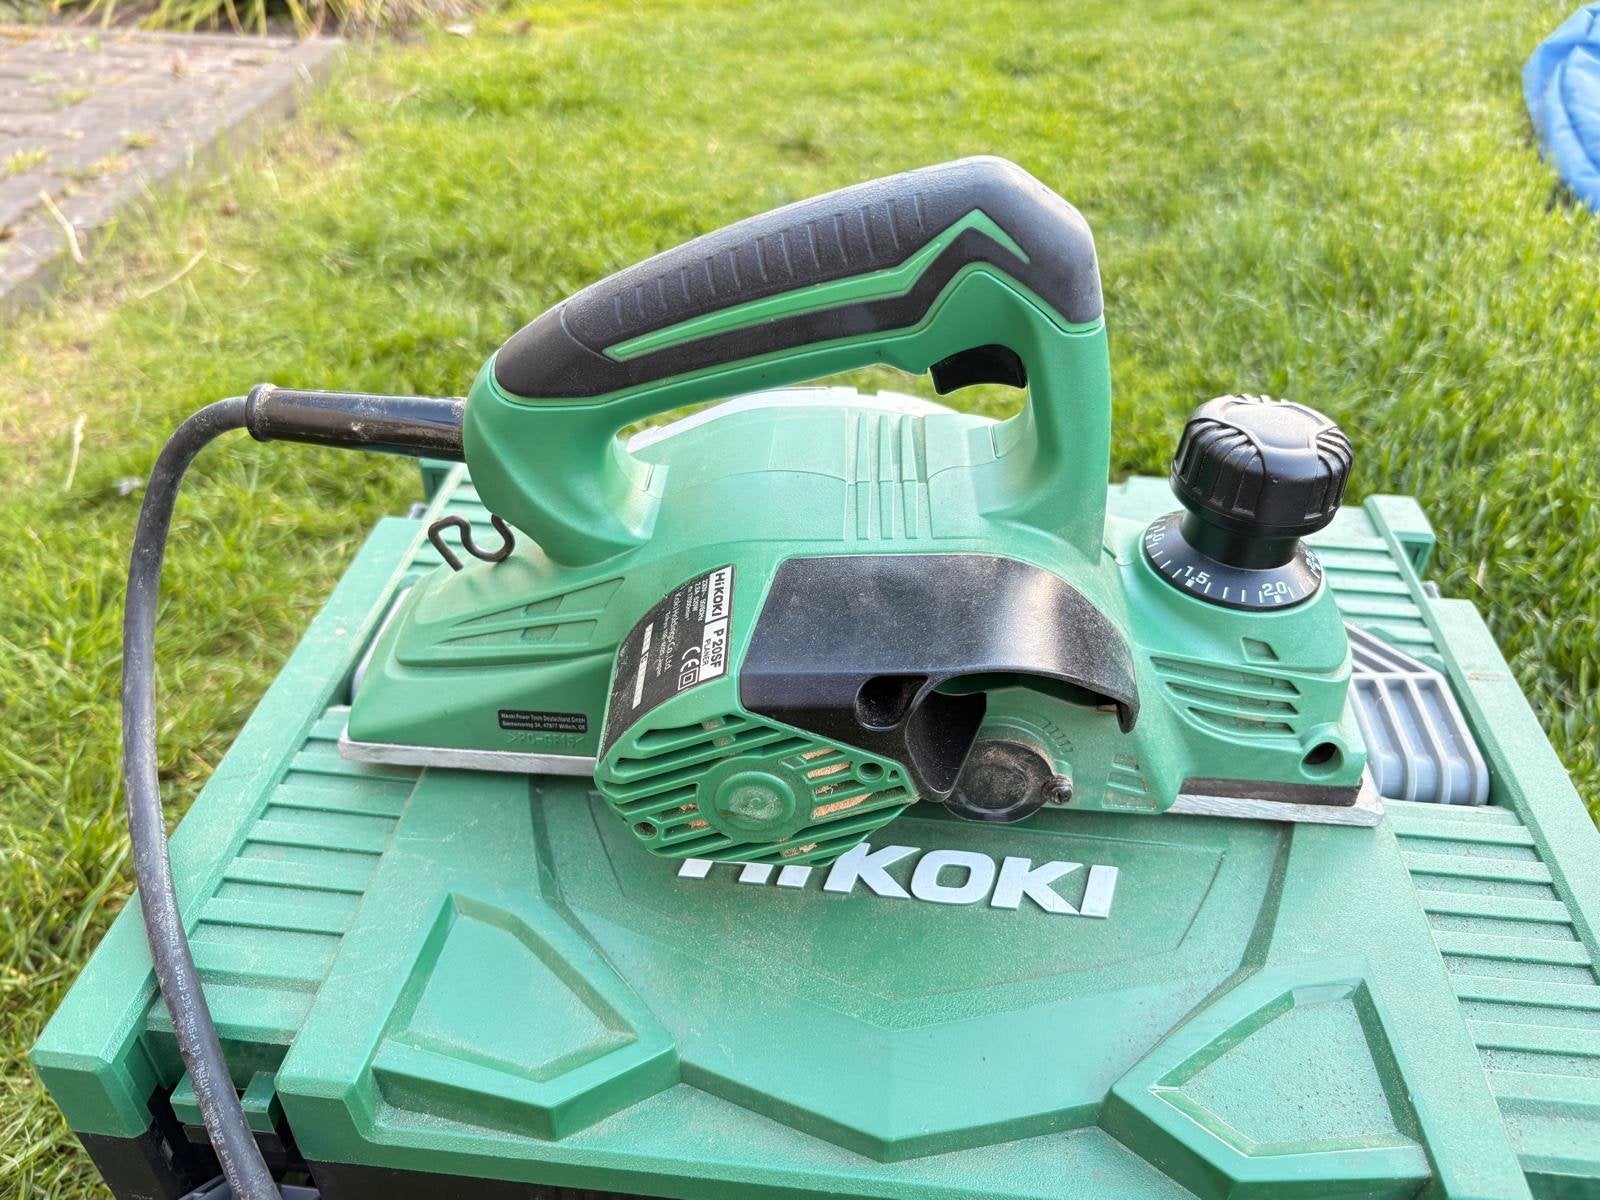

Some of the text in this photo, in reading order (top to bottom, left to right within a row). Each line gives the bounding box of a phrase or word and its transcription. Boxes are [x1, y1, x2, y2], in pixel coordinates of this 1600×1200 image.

[1184, 565, 1210, 584] 1.5
[1262, 581, 1288, 597] 2.0
[711, 571, 726, 617] HiKOKI
[667, 608, 680, 643] Holdings
[702, 638, 712, 666] PLANER
[710, 627, 725, 668] P 20SF
